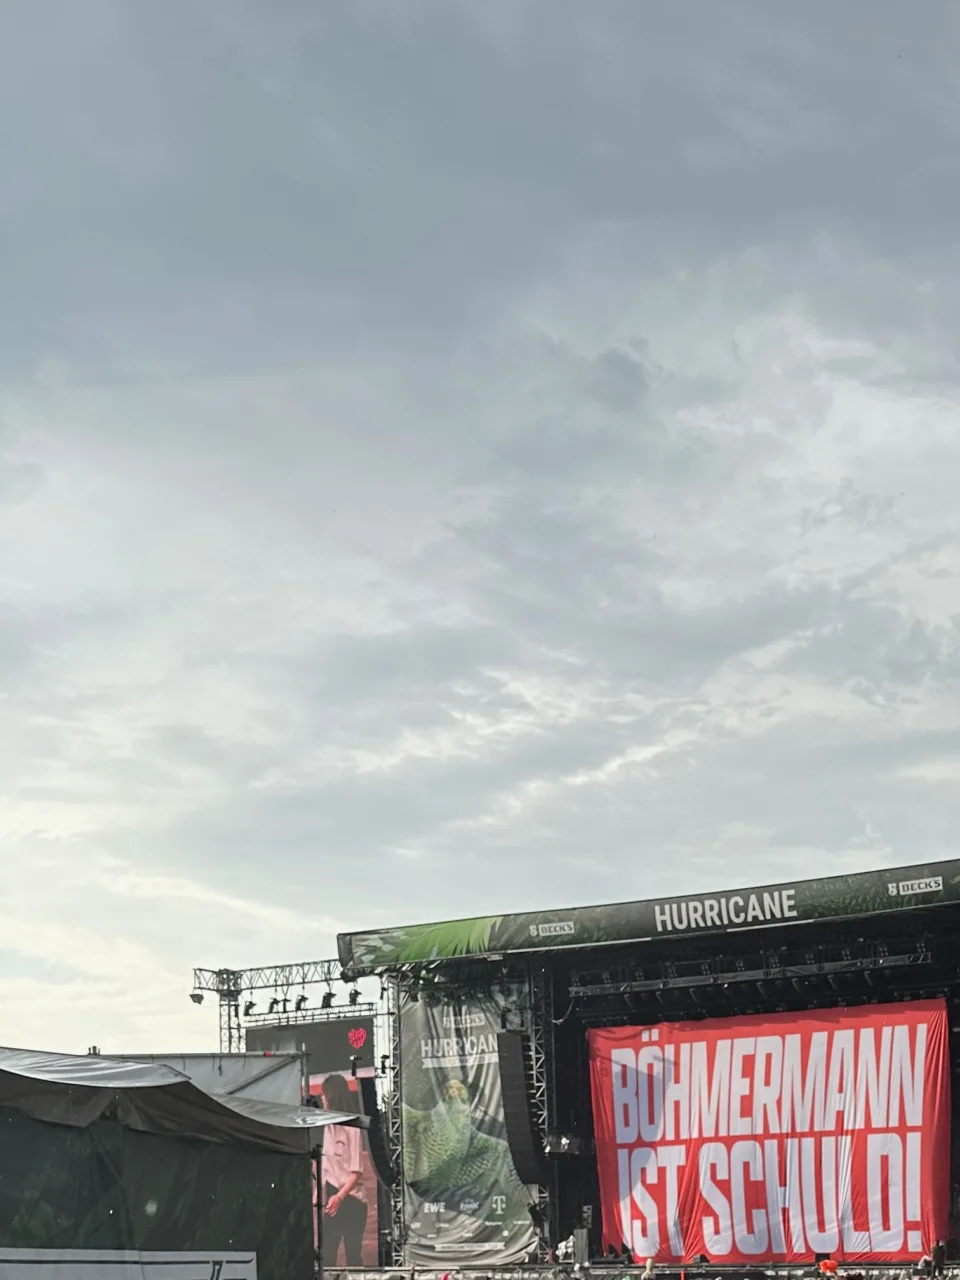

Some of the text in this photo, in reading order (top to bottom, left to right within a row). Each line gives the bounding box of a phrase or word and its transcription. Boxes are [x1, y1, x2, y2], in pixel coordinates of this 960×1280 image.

[902, 879, 942, 893] BECK'S
[654, 889, 798, 931] HURRICANE
[421, 1033, 498, 1058] HURRICAN
[611, 1023, 928, 1144] BÖHMERMANN
[424, 1202, 446, 1213] EWE
[617, 1132, 922, 1257] IST SCHULD!
